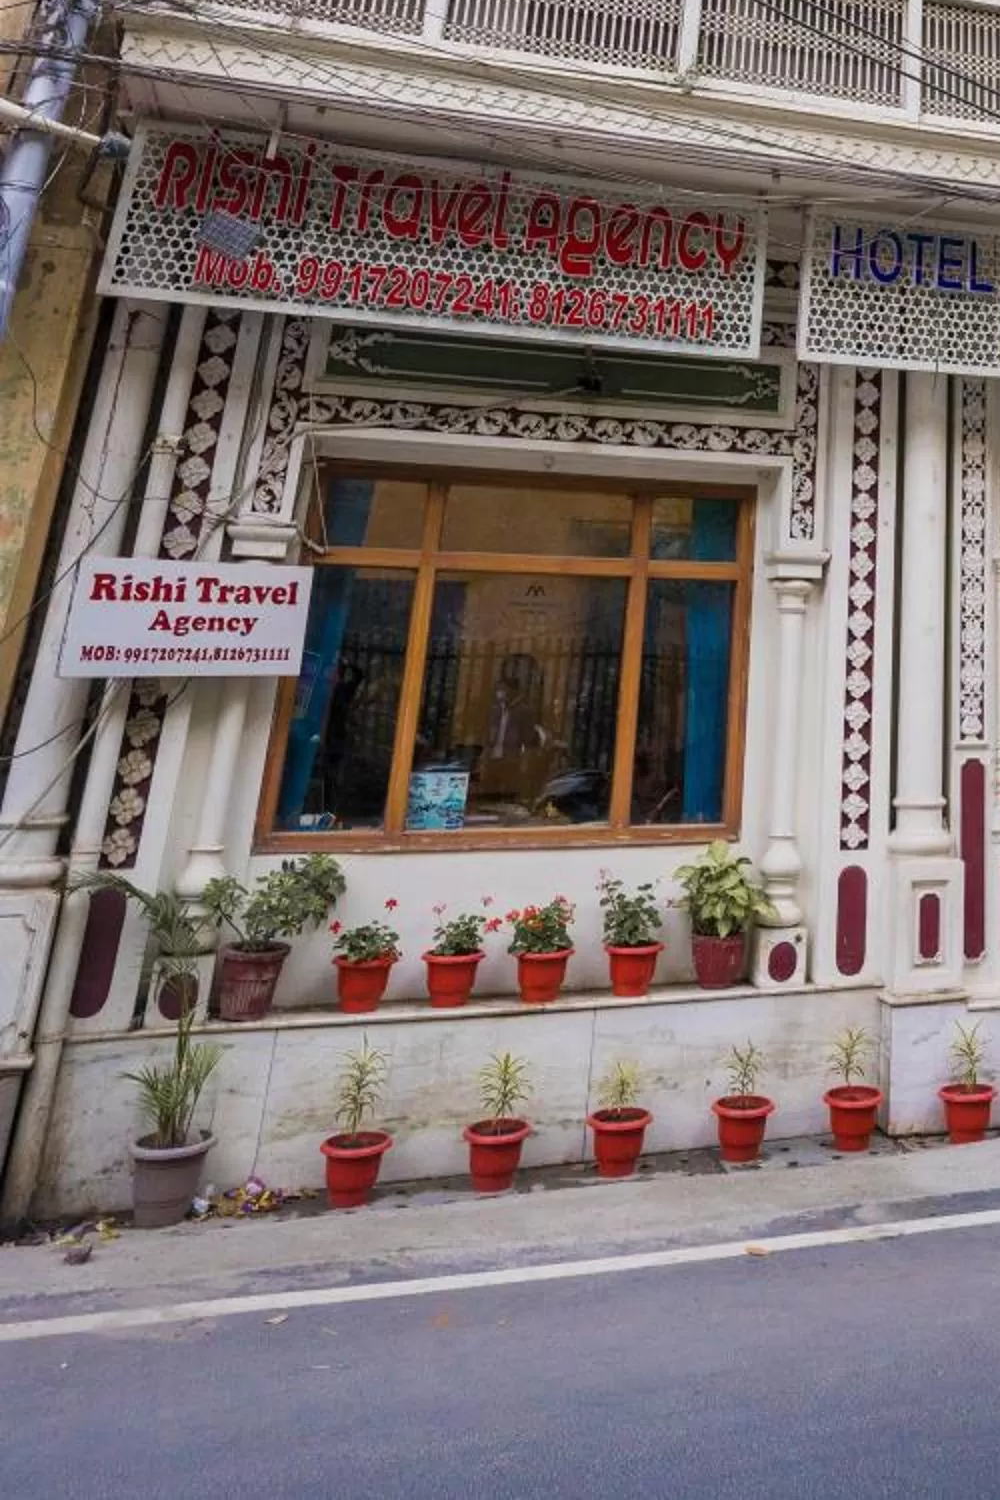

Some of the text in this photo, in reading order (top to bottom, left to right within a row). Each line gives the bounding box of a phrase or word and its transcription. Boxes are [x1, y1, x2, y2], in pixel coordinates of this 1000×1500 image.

[330, 165, 512, 249] Travel
[524, 190, 746, 278] Agency
[831, 225, 993, 293] HOTEL
[89, 573, 299, 606] Rishi Travel
[147, 609, 259, 636] Agency
[79, 645, 121, 662] MOB:
